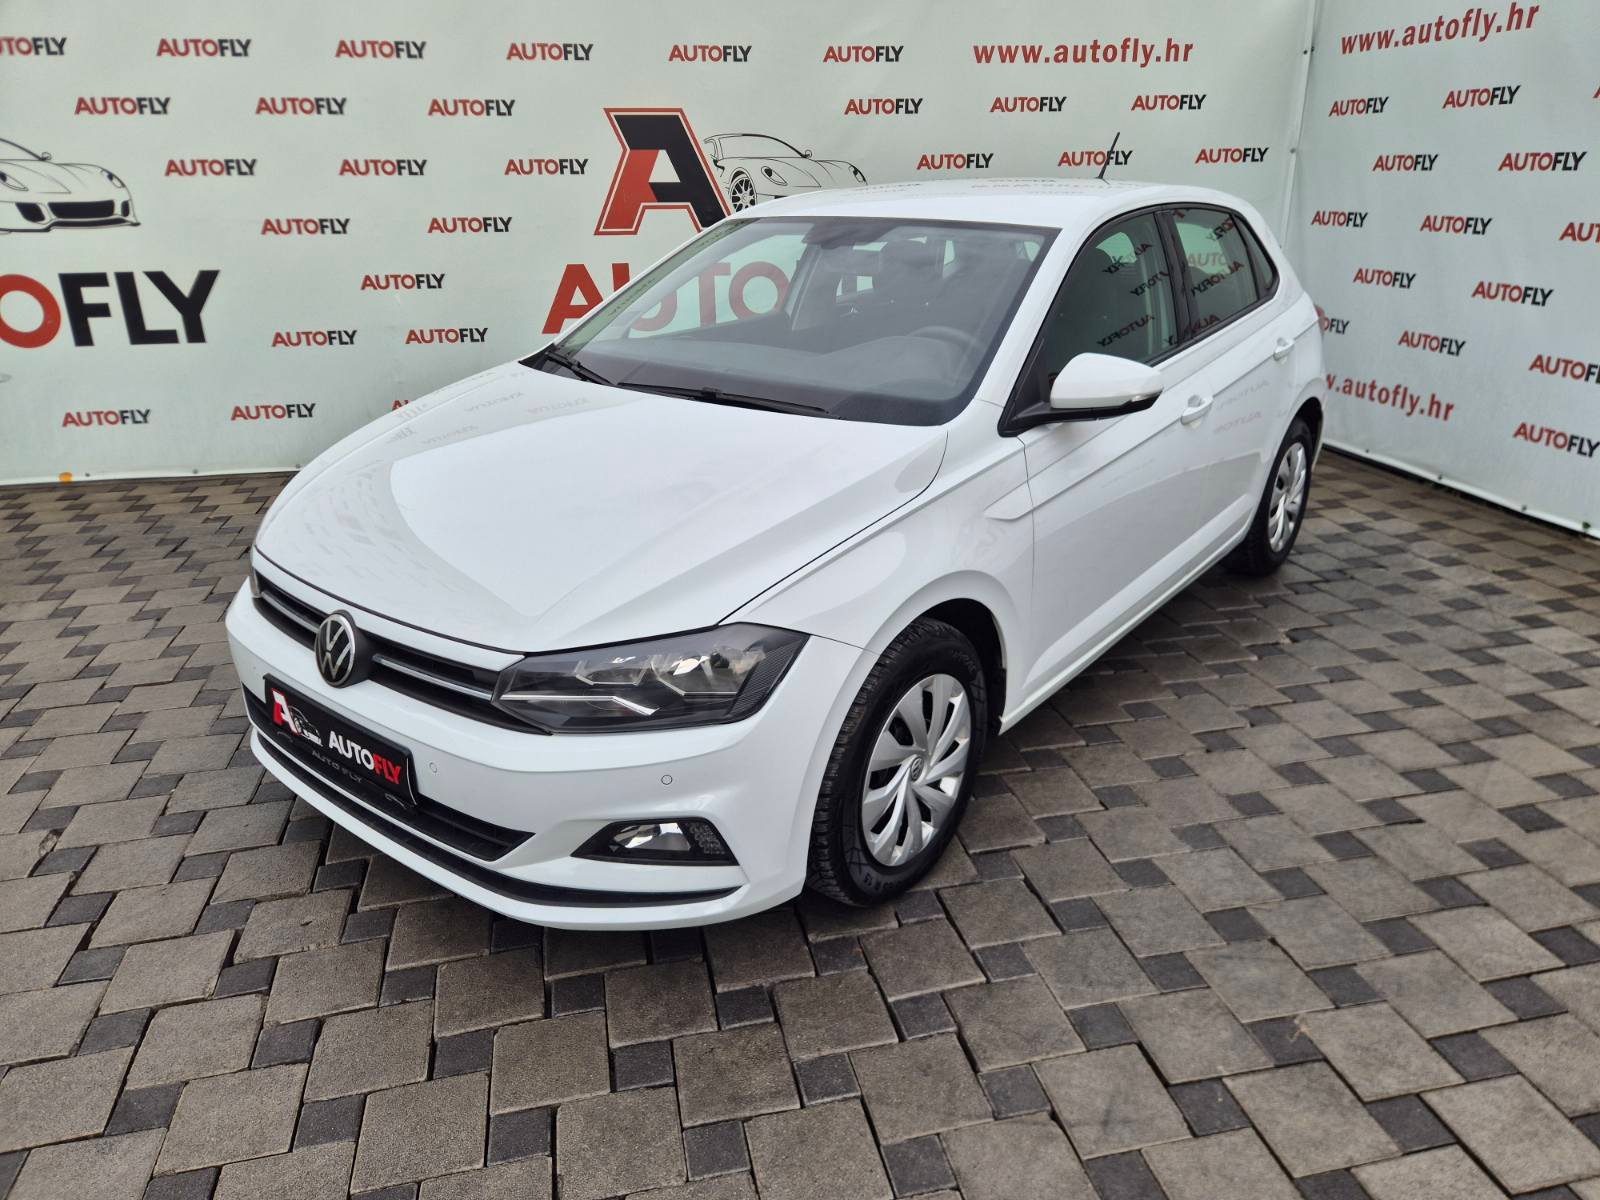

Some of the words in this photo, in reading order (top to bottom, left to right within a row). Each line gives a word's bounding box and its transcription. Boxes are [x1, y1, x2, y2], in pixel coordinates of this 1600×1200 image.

[1341, 2, 1539, 54] www.autofly.hr
[0, 36, 67, 56] TOFLY
[157, 38, 251, 57] AUTOFLY
[335, 40, 426, 59] AUTOFLY
[507, 43, 593, 61] AUTOFLY
[669, 45, 752, 62] AUTOFLY
[823, 45, 904, 62] AUTOFLY
[973, 37, 1194, 68] www.autofly.hr
[990, 96, 1067, 113] AUTOFLY
[1131, 94, 1207, 111] AUTOFLY
[1442, 85, 1521, 109] AUTOFLY
[75, 97, 170, 115] AUTOFLY
[256, 97, 348, 115] AUTOFLY
[428, 99, 515, 117] AUTOFLY
[844, 98, 923, 115] AUTOFLY
[1328, 96, 1389, 117] AUTOFLY
[917, 153, 993, 170] AUTOFLY
[1058, 150, 1133, 166] AUTOFLY
[1195, 147, 1269, 164] AUTOFLY
[1372, 154, 1438, 171] AUTOFLY
[1498, 152, 1587, 171] AUTOFLY
[165, 159, 257, 176] AUTOFLY
[339, 159, 427, 176] AUTOFLY
[504, 158, 588, 175] AUTOFLY
[261, 218, 350, 235] AUTOFLY
[428, 217, 512, 233] AUTOFLY
[1311, 211, 1368, 228] AUTOFLY
[1420, 215, 1492, 235] AUTOFLY
[361, 273, 445, 290] AUTOFLY
[1353, 268, 1416, 289] AUTOFLY
[1472, 281, 1554, 307] AUTOFLY
[272, 330, 357, 347] AUTOFLY
[405, 328, 489, 344] AUTOFLY
[1398, 330, 1466, 356] AUTOFLY
[62, 409, 150, 427] AUTOFLY
[231, 403, 316, 420] AUTOFLY
[1513, 422, 1600, 458] AUTOFLY
[328, 730, 401, 785] AUTOFLY
